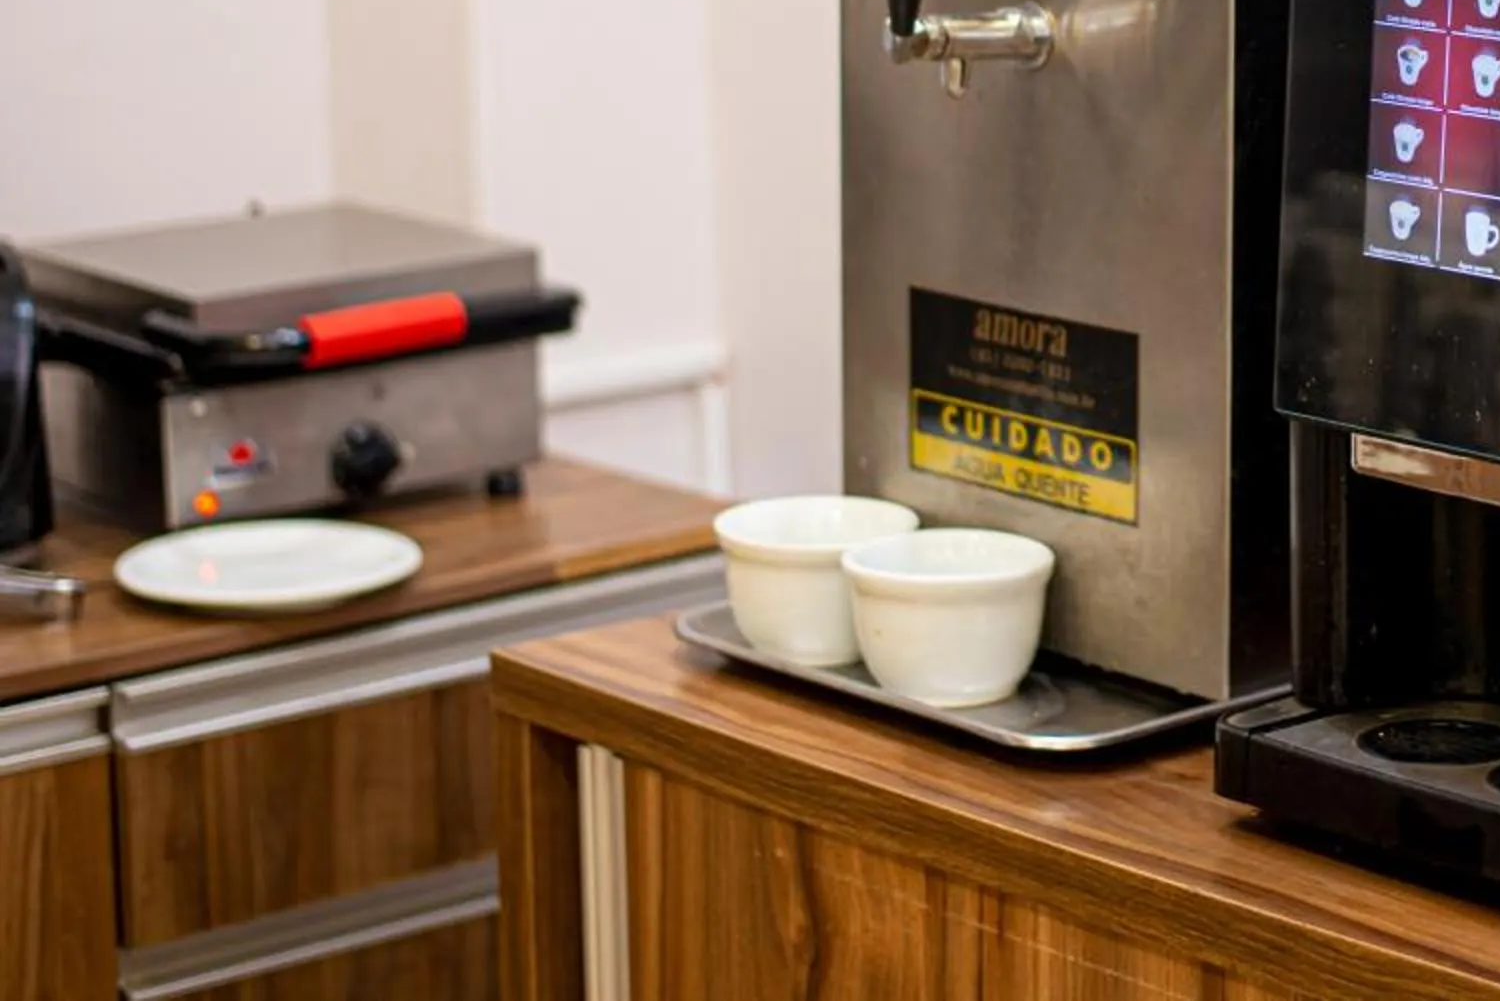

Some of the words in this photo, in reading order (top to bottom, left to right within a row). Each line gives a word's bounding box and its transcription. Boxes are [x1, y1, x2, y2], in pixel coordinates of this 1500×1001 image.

[975, 307, 1067, 358] amora
[941, 405, 1113, 471] CUIDADO
[1015, 466, 1092, 507] QUENTE
